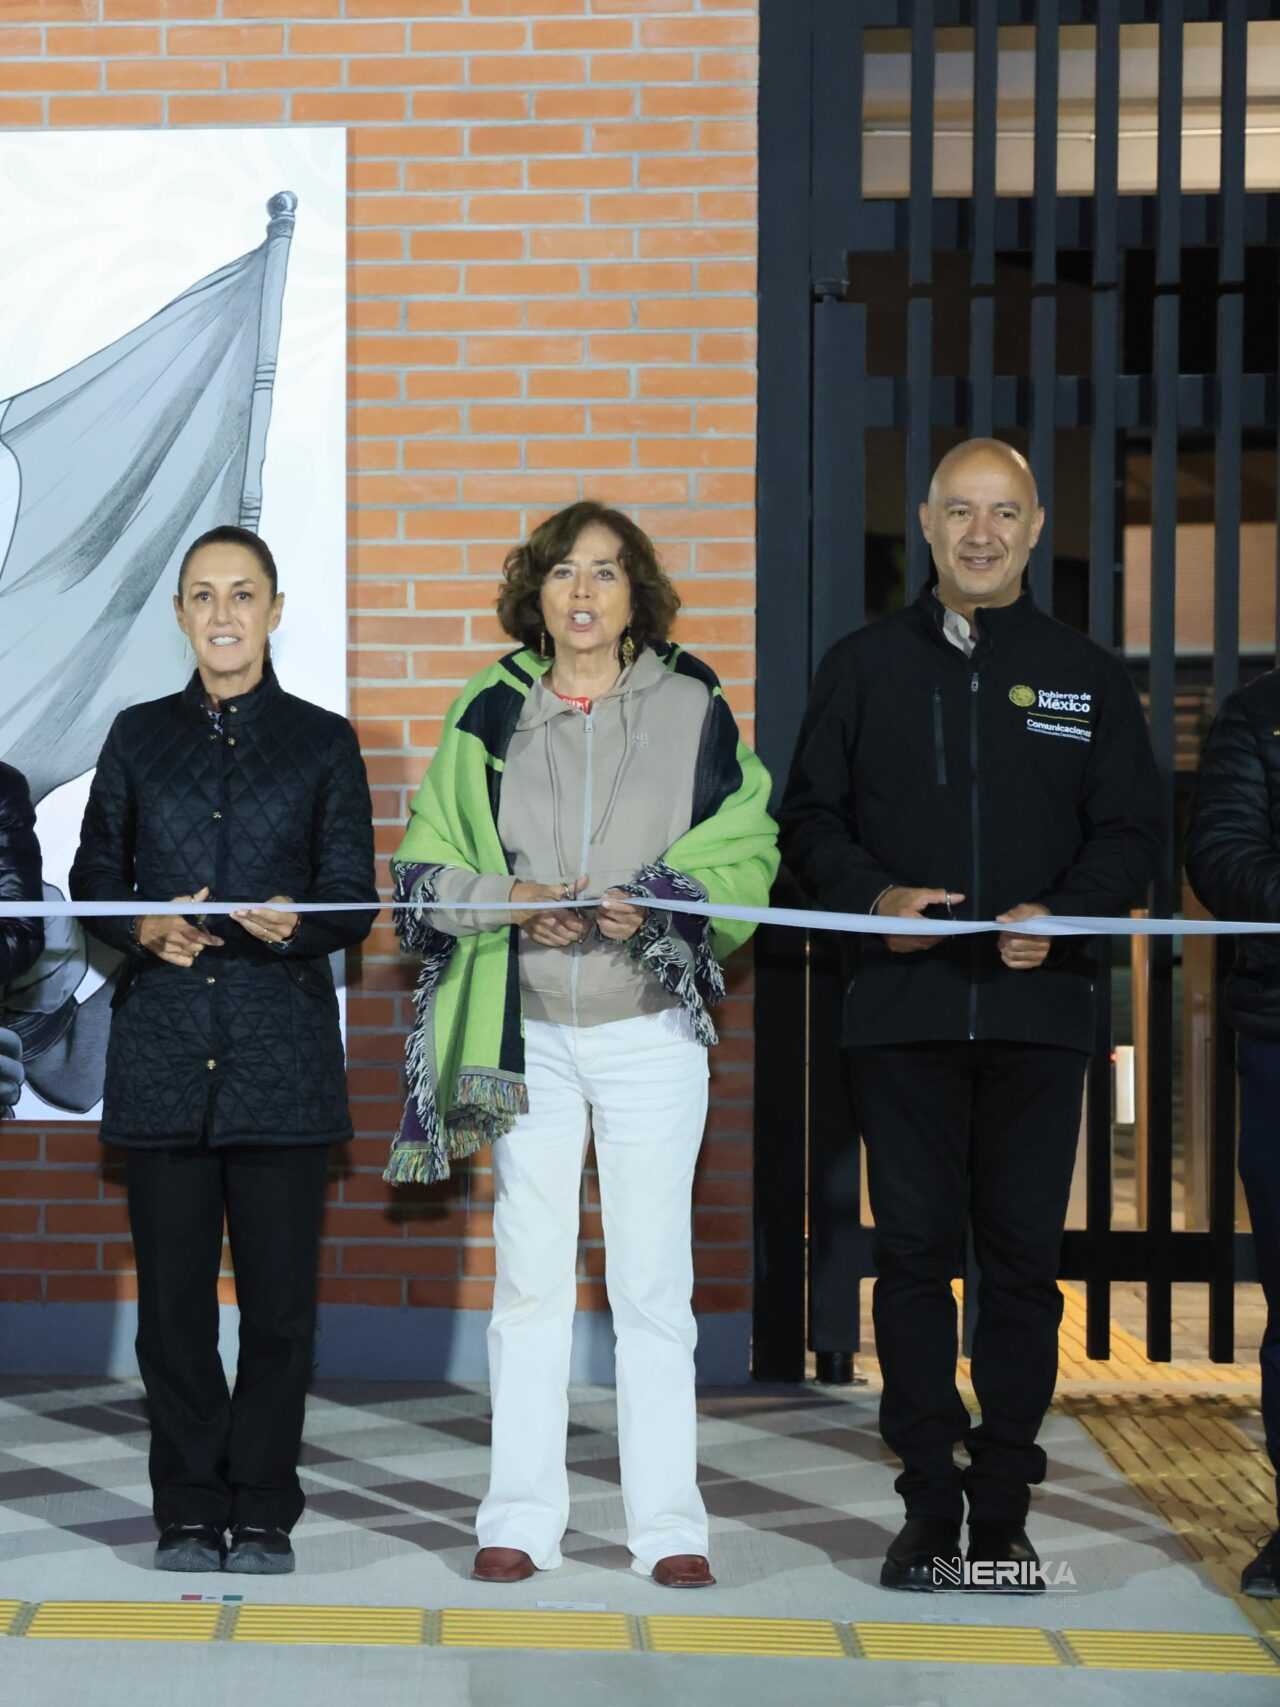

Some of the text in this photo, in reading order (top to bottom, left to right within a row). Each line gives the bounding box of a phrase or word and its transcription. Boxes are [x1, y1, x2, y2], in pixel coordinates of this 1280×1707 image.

[1038, 689, 1091, 701] Gobierno de
[1038, 696, 1091, 712] México
